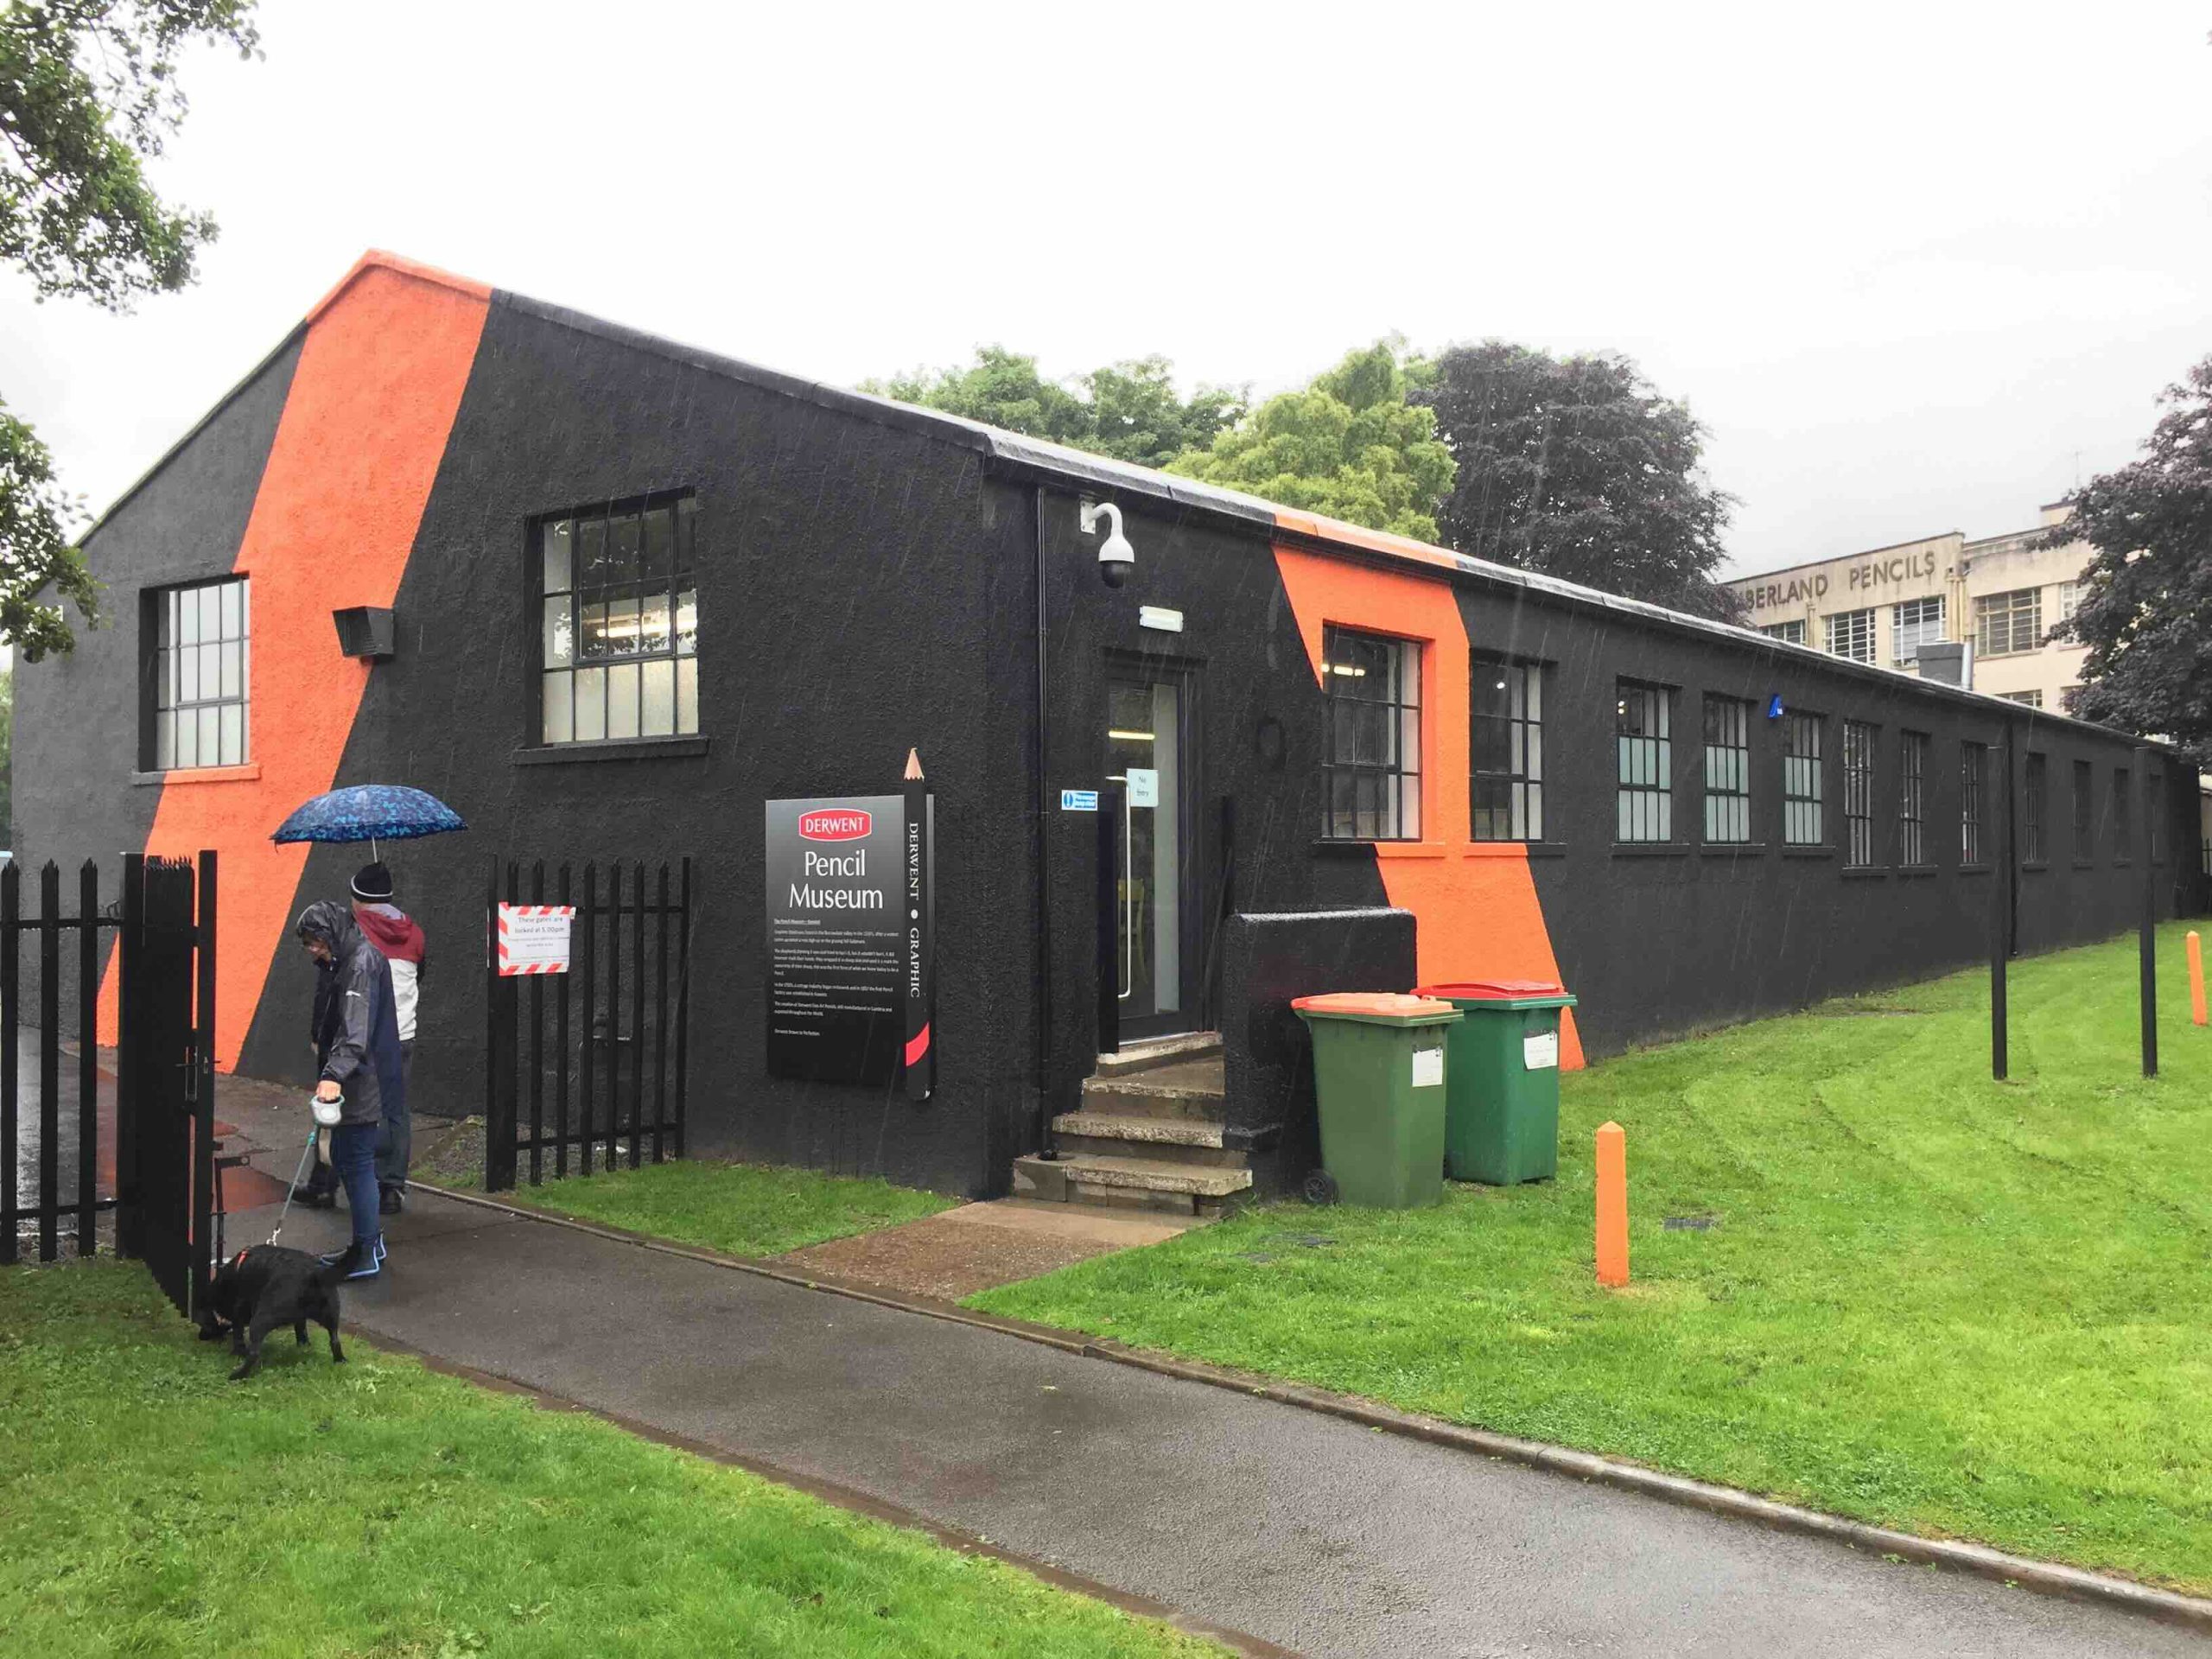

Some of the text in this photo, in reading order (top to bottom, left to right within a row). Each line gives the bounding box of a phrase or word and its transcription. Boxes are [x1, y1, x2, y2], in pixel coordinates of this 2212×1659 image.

[1745, 550, 1936, 610] BERLAND PENCILS
[805, 817, 864, 835] DERWENT
[804, 849, 866, 876] Pencil
[789, 883, 883, 909] Museum
[909, 823, 920, 998] DERWENT GRAPHIC
